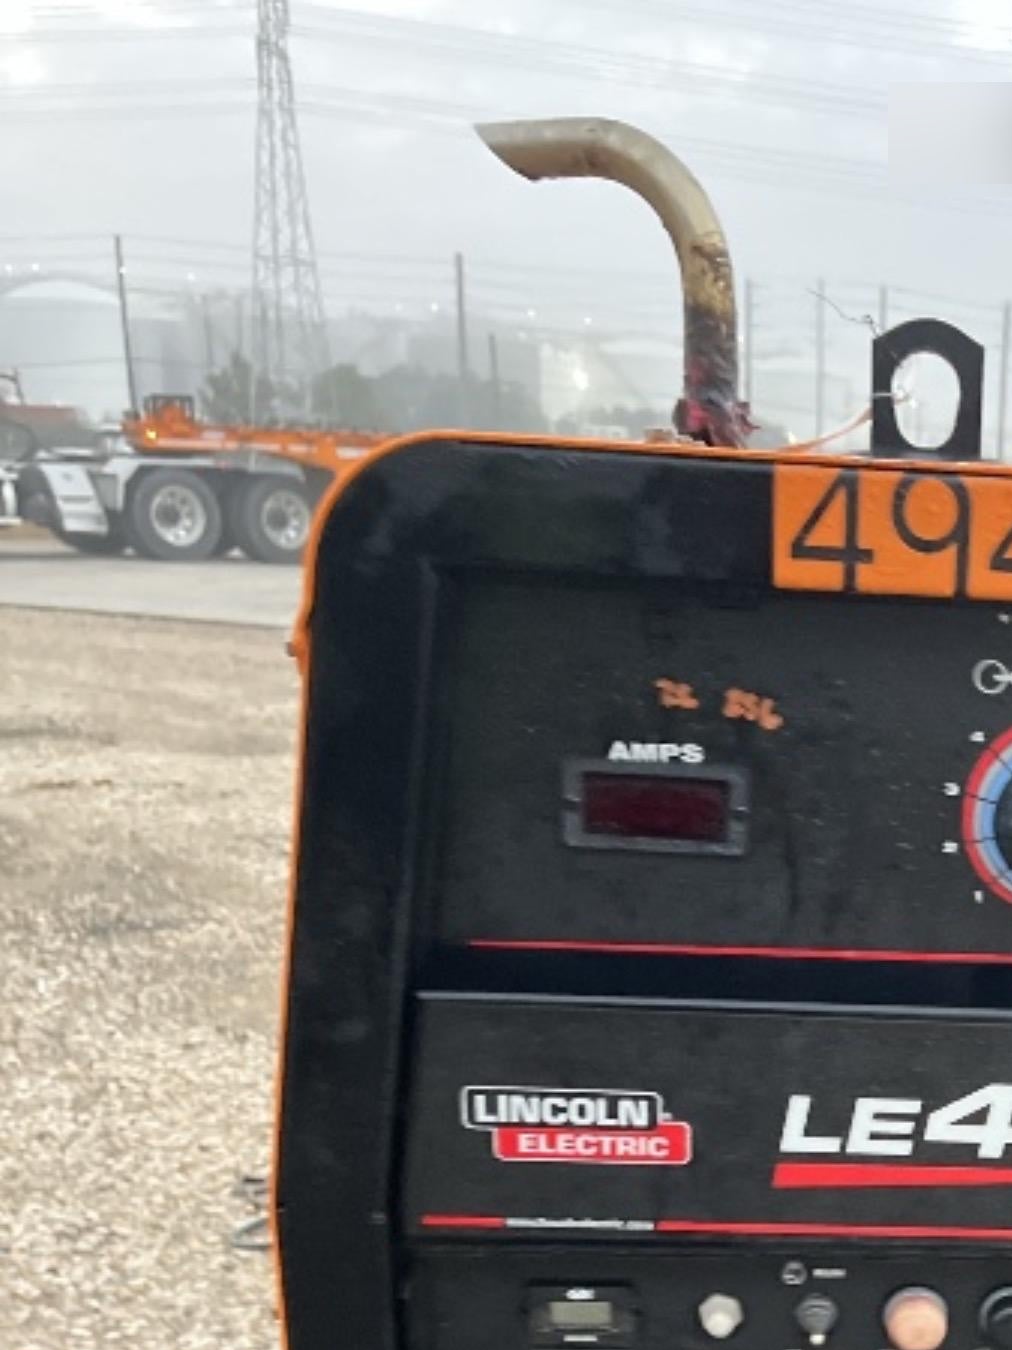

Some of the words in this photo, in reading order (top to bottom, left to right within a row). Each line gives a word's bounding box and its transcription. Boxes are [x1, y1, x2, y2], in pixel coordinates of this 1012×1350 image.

[608, 741, 704, 763] AMPS
[472, 1092, 650, 1128] LINCOLN
[516, 1132, 671, 1158] ELECTRIC
